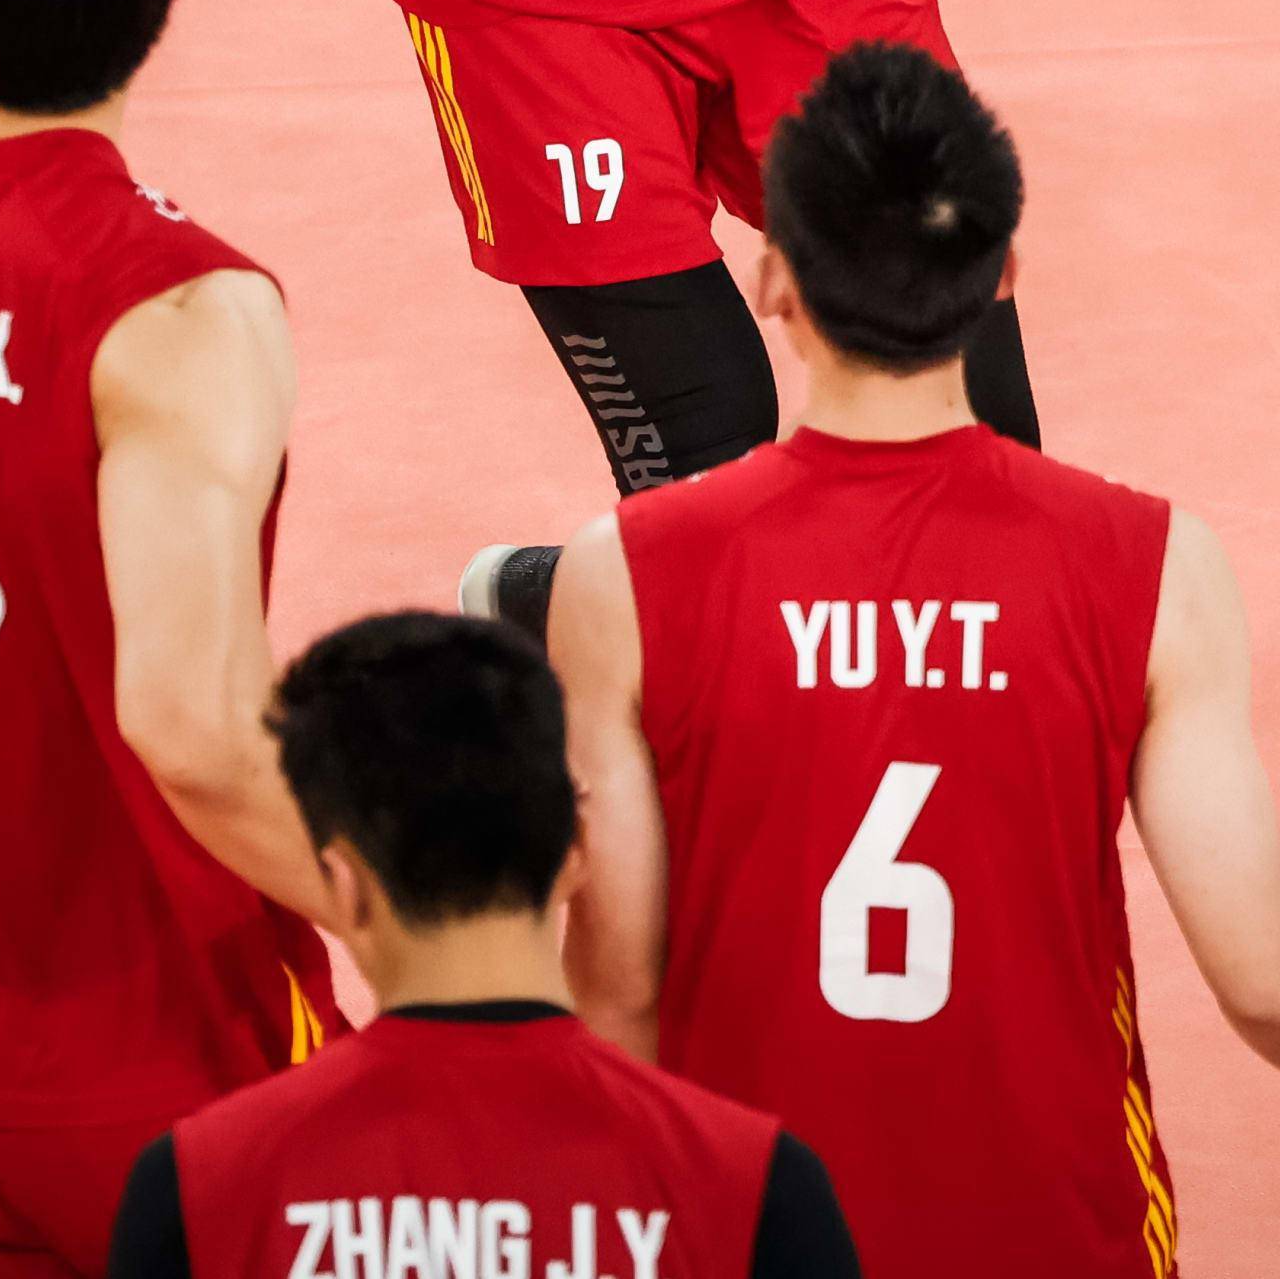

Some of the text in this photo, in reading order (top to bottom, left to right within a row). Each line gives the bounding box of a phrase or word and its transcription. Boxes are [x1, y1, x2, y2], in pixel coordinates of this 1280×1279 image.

[545, 138, 624, 225] 19
[779, 599, 1009, 691] YU Y.T.
[819, 760, 955, 1023] 6
[285, 1195, 671, 1279] ZHANG JY
